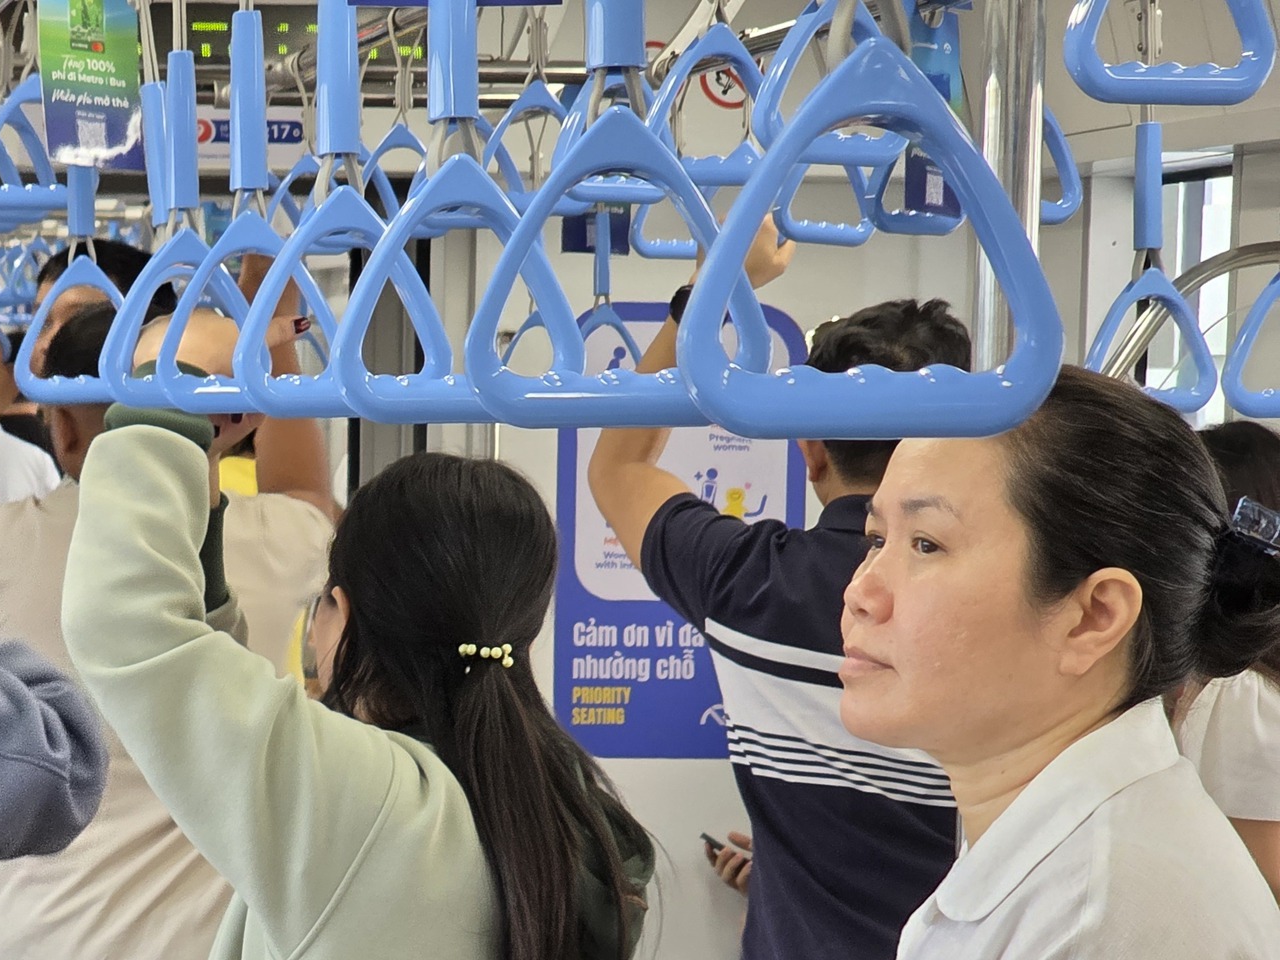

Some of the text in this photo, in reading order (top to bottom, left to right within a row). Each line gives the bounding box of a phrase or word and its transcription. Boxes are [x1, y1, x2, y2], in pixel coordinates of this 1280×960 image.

[86, 58, 116, 73] 100%
[78, 73, 104, 85] Metro
[109, 77, 126, 88] Bus
[713, 444, 750, 452] women
[573, 617, 618, 647] Cảm
[623, 623, 650, 647] ơn
[655, 620, 674, 647] vì
[572, 649, 695, 682] nhường chỗ
[572, 686, 631, 704] PRIORITY
[571, 707, 625, 725] SEATING
